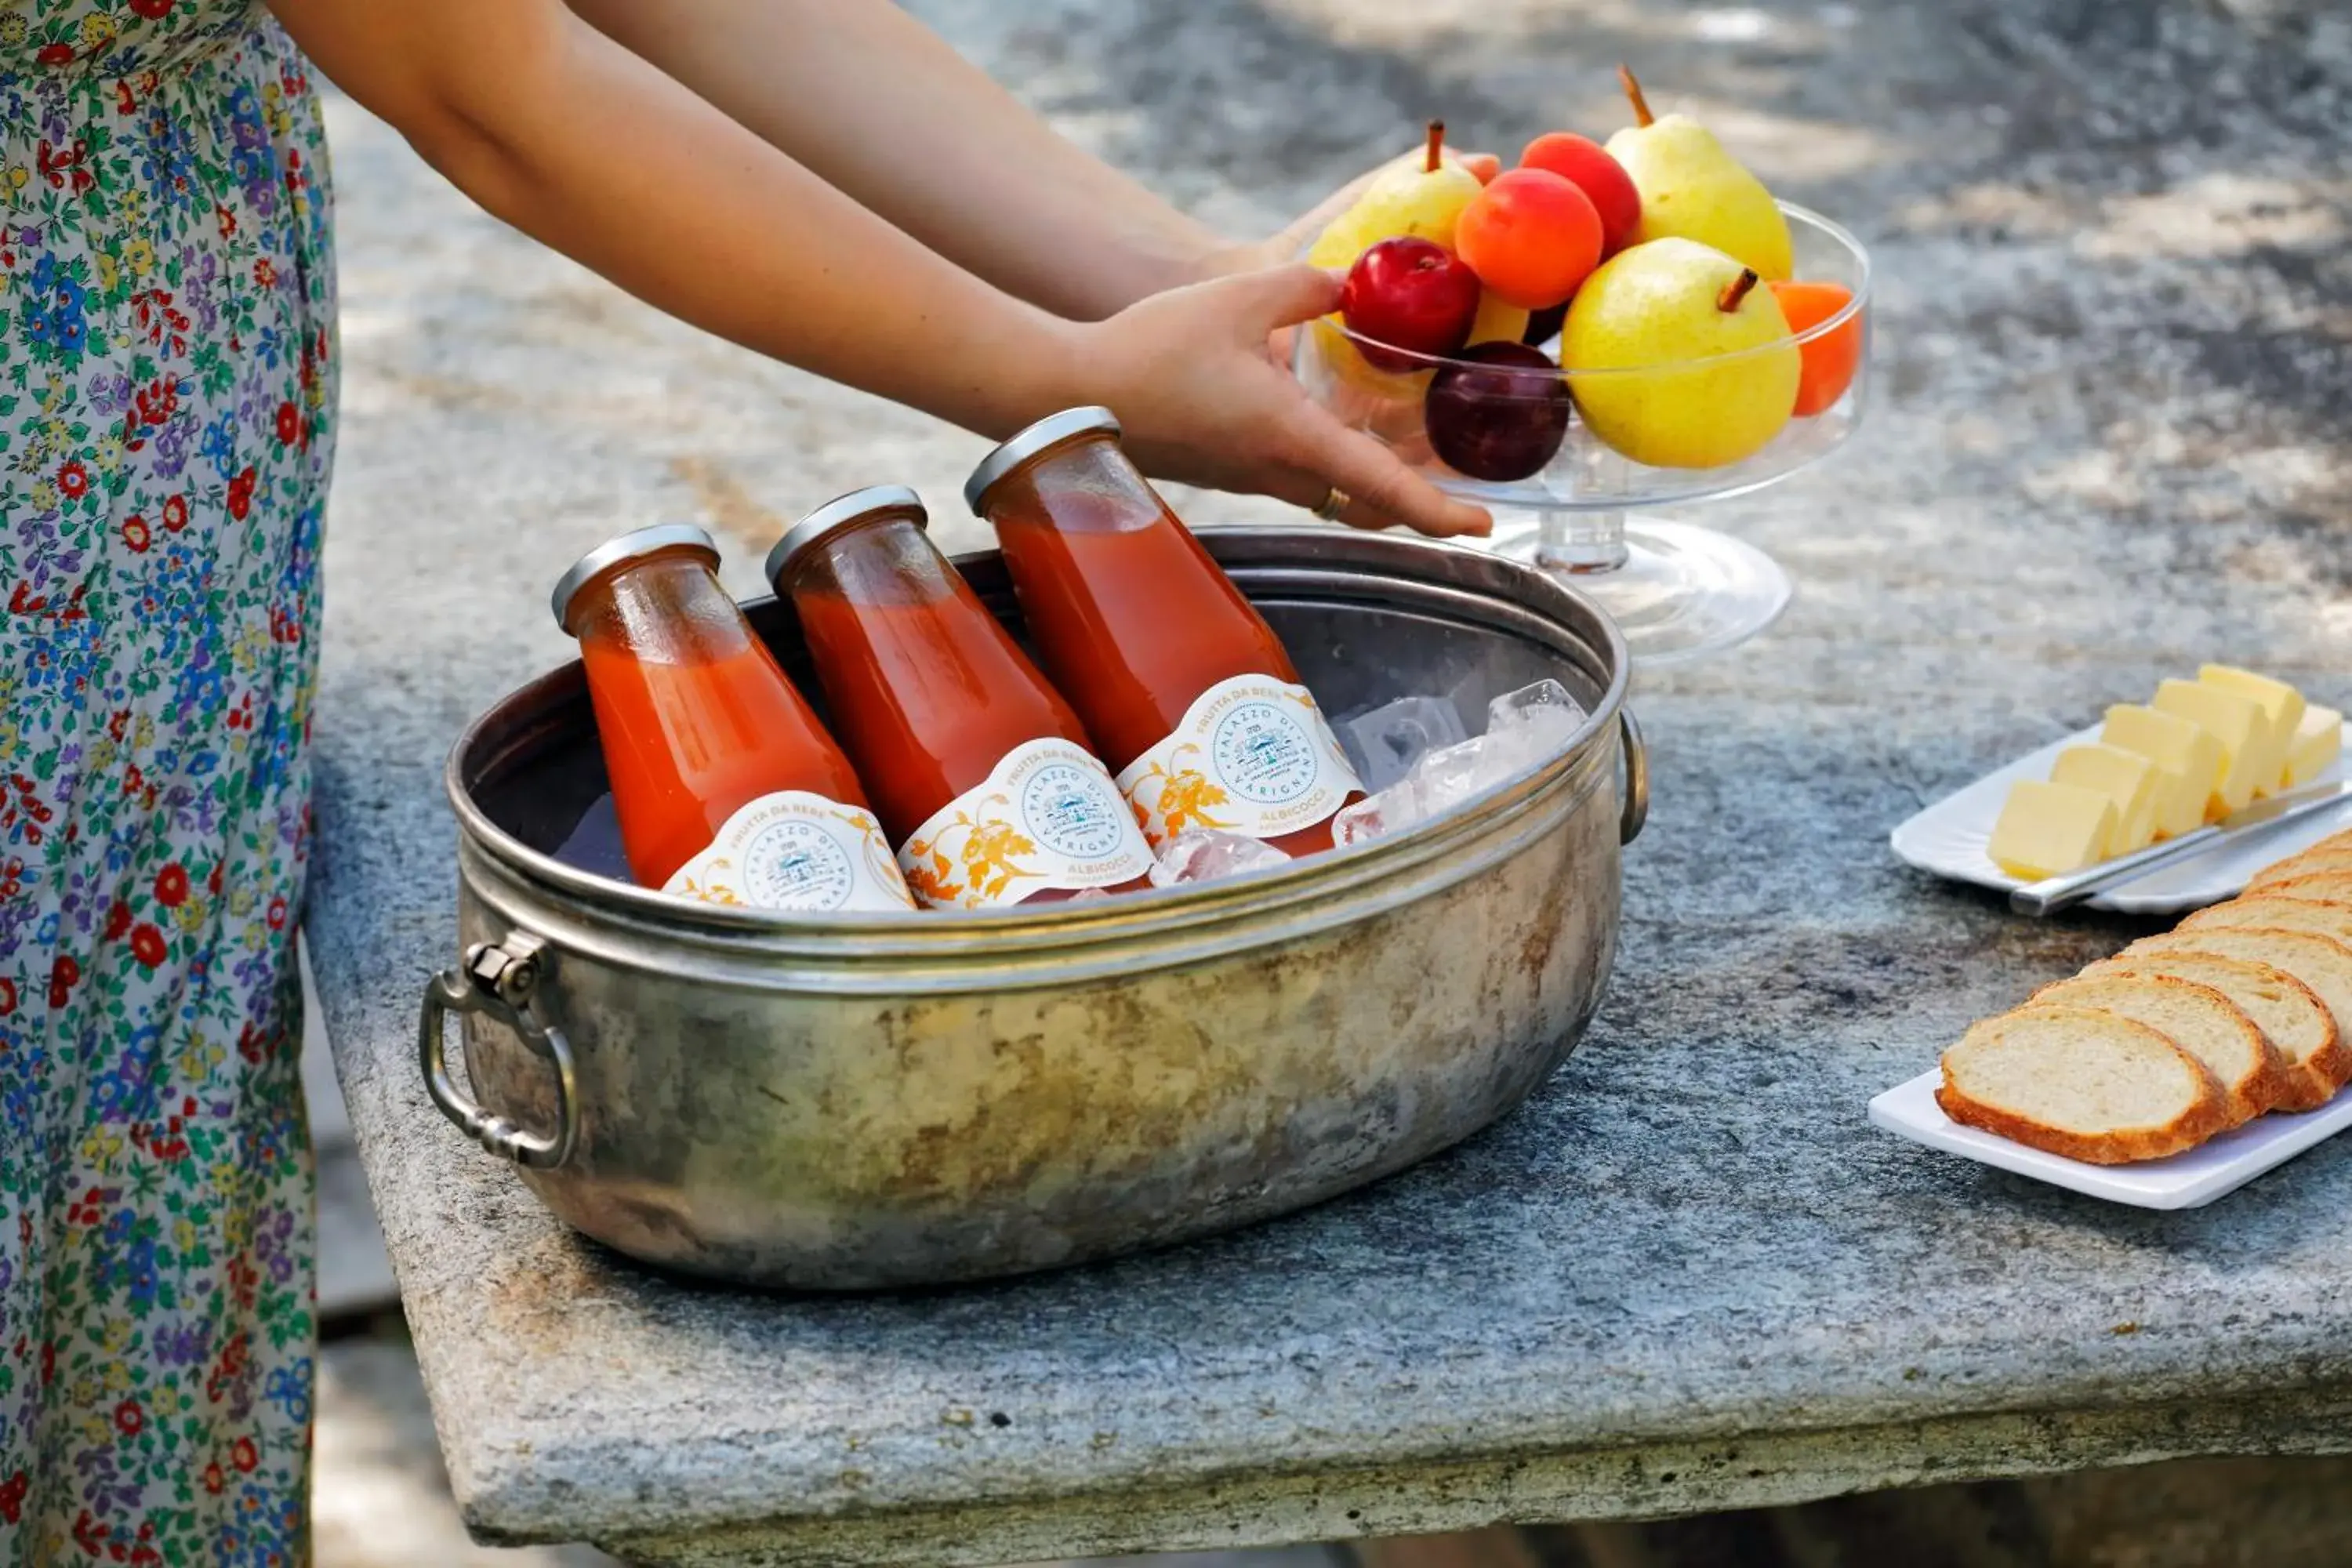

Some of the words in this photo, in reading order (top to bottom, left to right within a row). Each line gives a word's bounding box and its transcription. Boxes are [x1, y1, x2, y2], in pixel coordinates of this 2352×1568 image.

[1196, 694, 1232, 735] FRUTTA
[1220, 710, 1272, 758] PALAZZO
[1007, 753, 1041, 787] FRUTTA
[1029, 770, 1080, 812] PALAZZO
[731, 810, 771, 850] FRUTTA
[750, 825, 811, 875] PALAZZO
